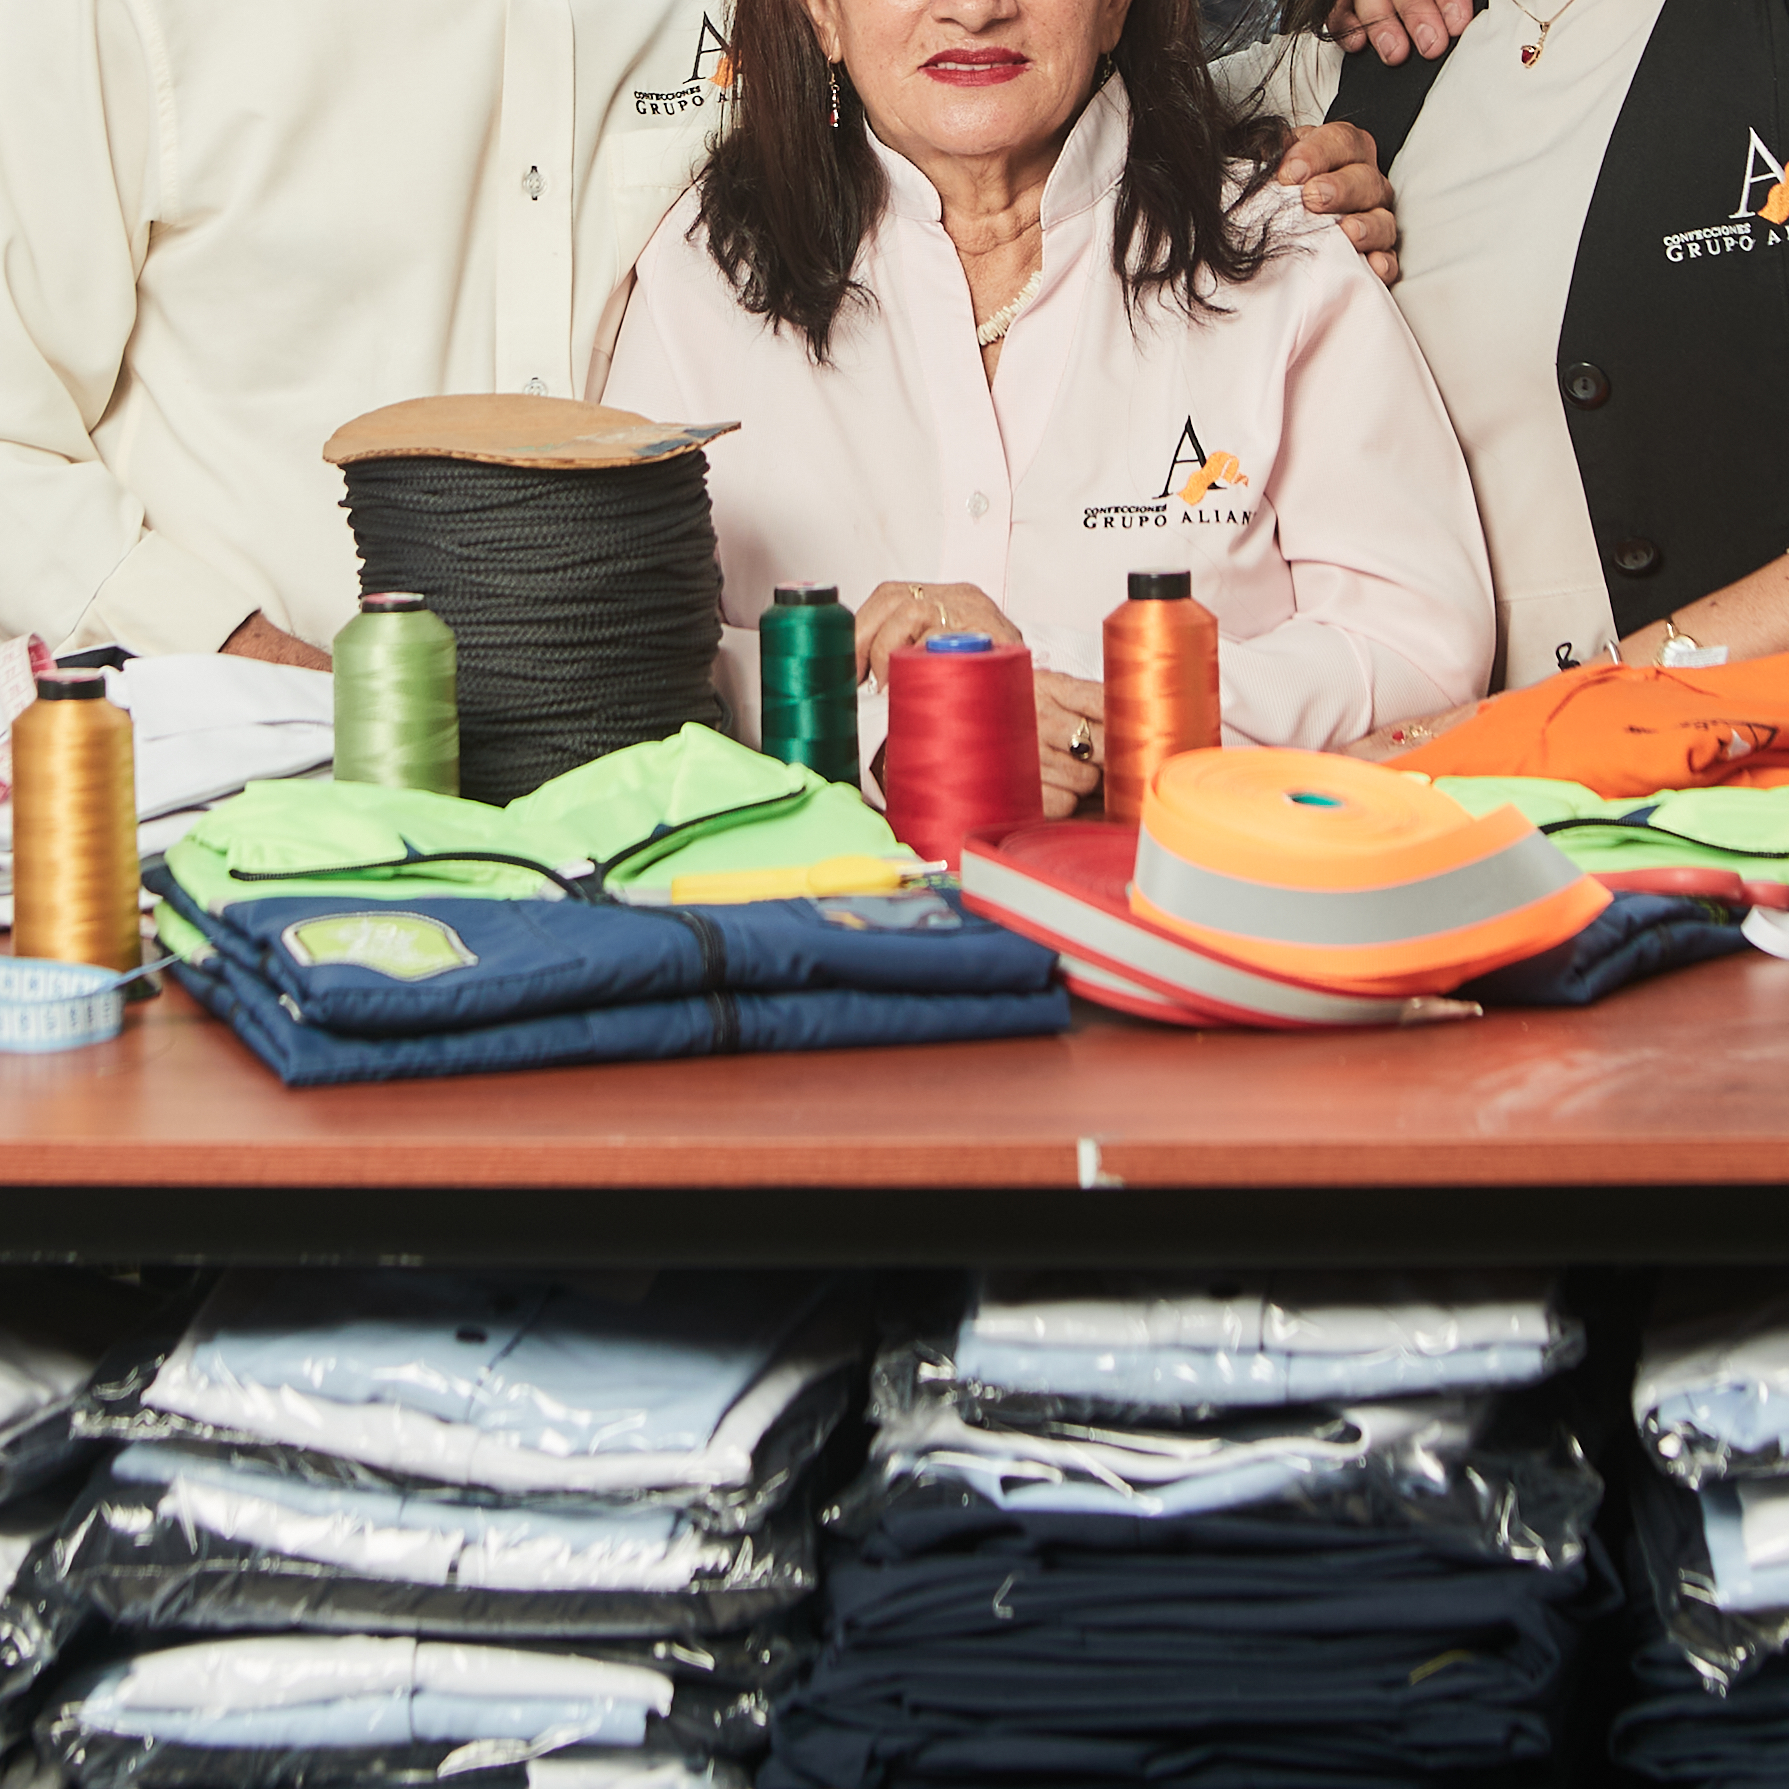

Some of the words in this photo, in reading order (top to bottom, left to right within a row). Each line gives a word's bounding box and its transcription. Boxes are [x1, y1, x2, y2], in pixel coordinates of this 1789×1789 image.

[635, 95, 705, 116] GRUPO
[1663, 222, 1752, 248] CONFECCIONES
[1665, 235, 1756, 263] GRUPO
[1151, 414, 1228, 500] A
[1083, 514, 1167, 529] GRUPO
[1181, 509, 1257, 526] ALIAN
